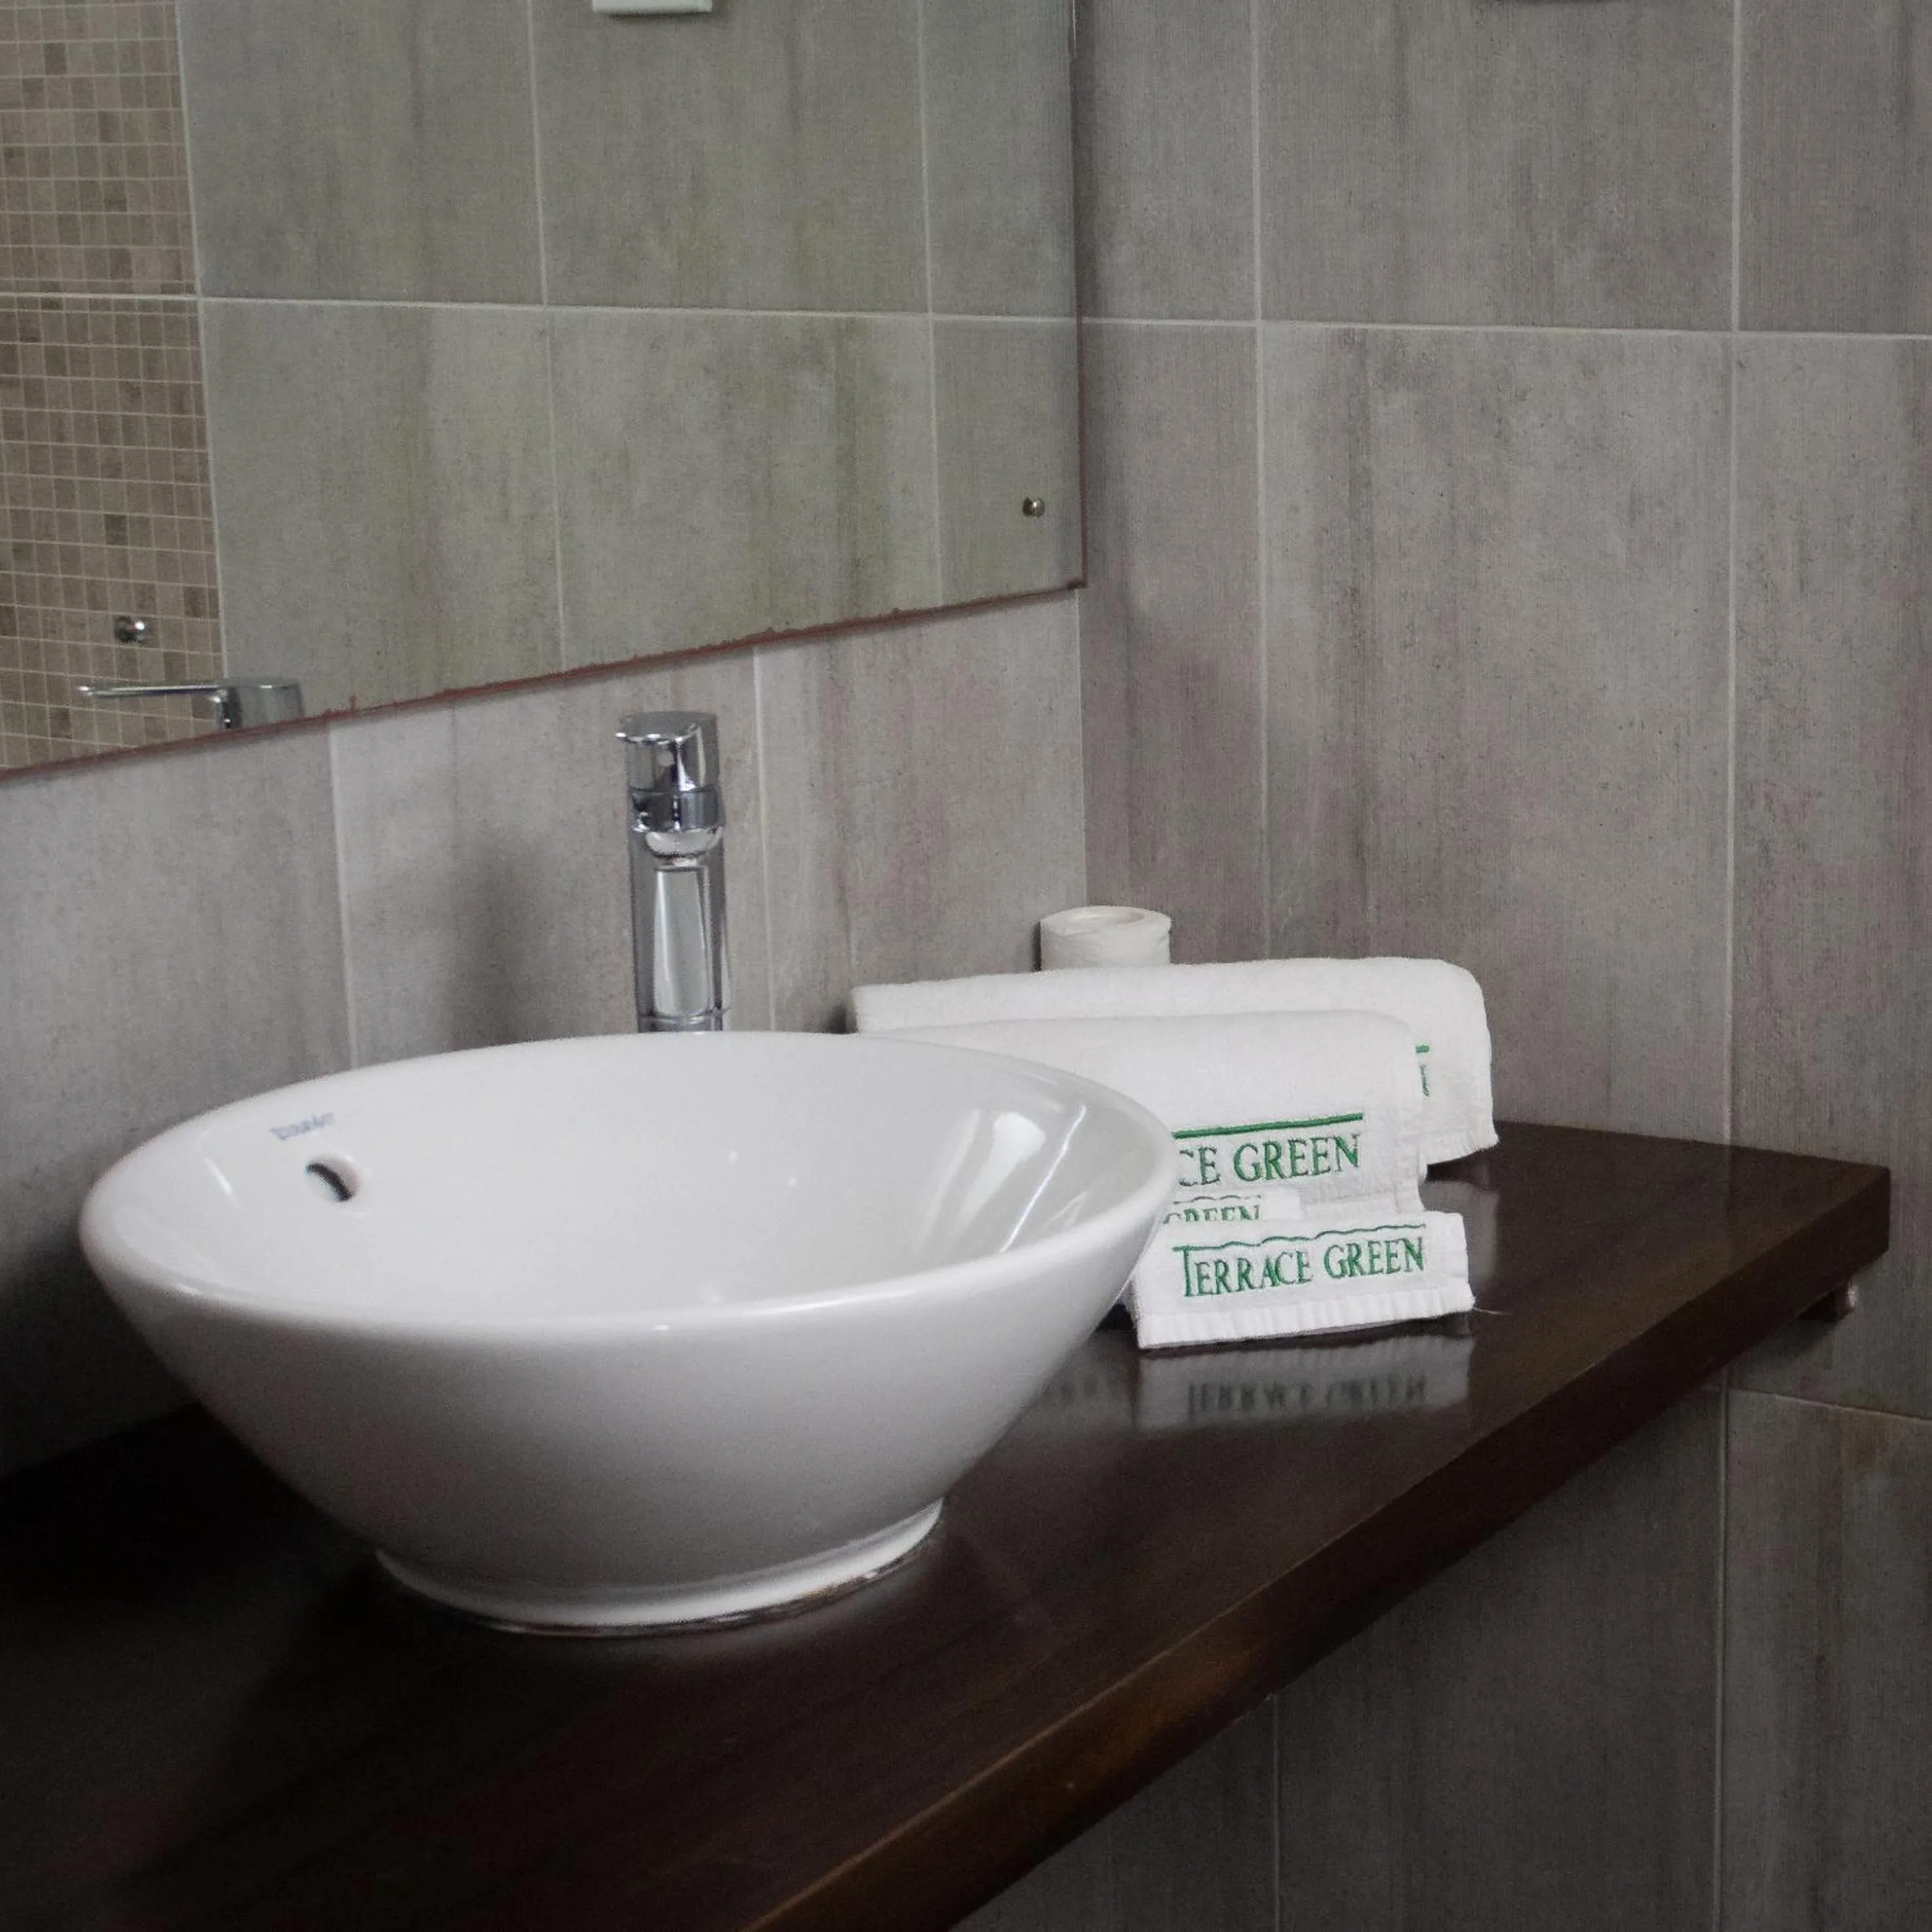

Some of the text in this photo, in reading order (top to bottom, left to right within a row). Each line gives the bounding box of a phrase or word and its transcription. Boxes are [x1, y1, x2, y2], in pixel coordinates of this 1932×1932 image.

[1233, 1134, 1360, 1181] GREEN
[1180, 1236, 1425, 1297] TERRACE GREEN
